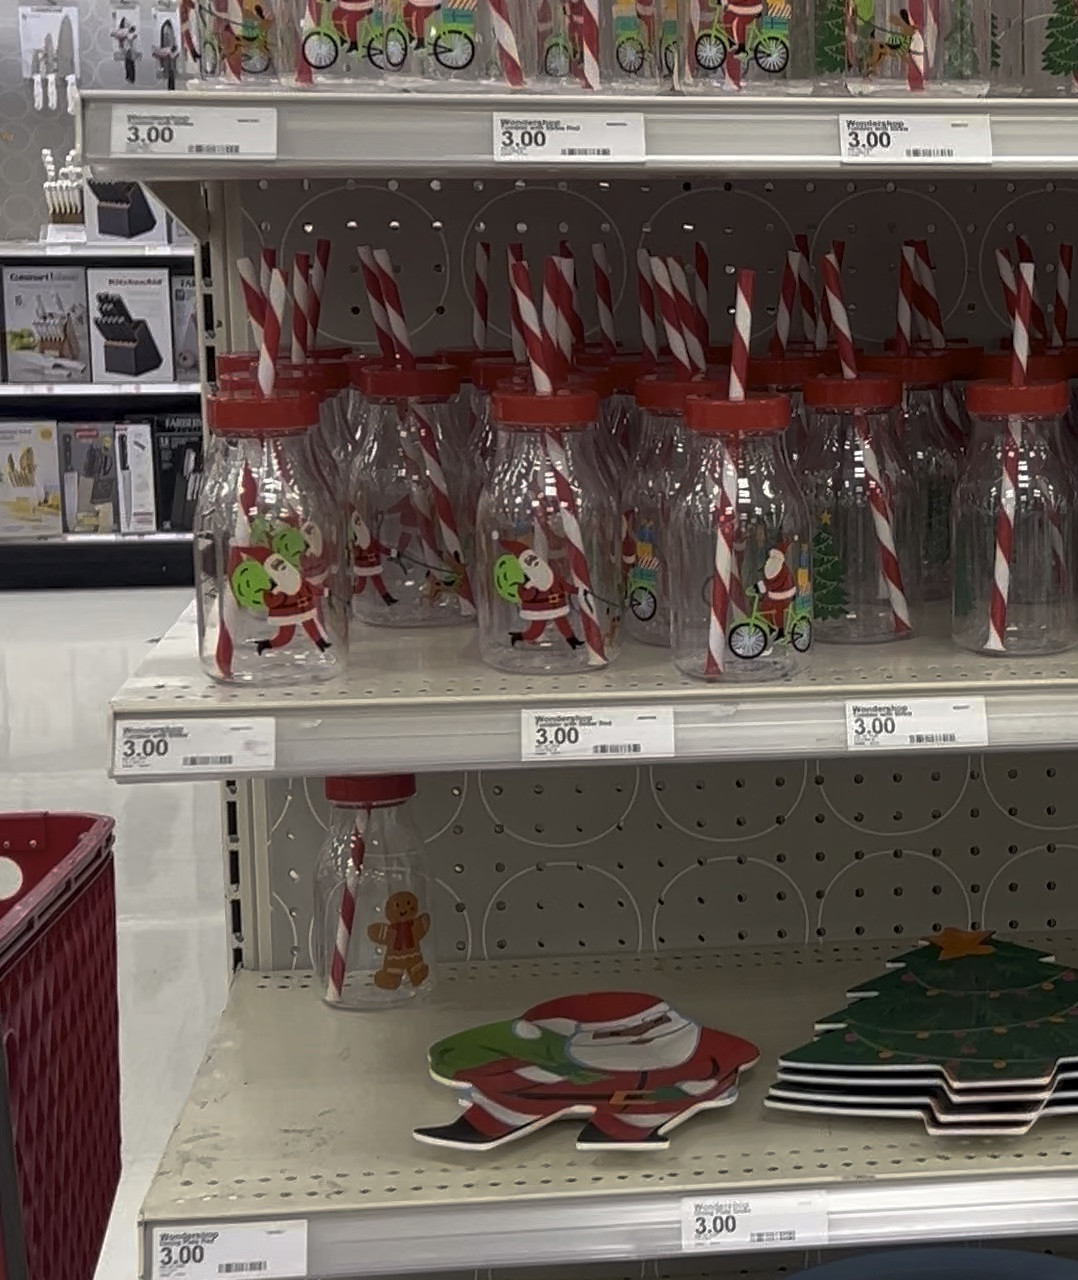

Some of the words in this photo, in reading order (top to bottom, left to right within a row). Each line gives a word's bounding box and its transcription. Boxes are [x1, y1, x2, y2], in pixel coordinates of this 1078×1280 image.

[127, 126, 174, 143] 3.00
[501, 130, 546, 147] 3.00
[848, 131, 891, 148] 3.00
[854, 717, 896, 735] 3.00
[536, 727, 579, 744] 3.00
[123, 739, 168, 757] 3.00
[695, 1215, 735, 1234] 3.00
[160, 1245, 204, 1265] 3.00
